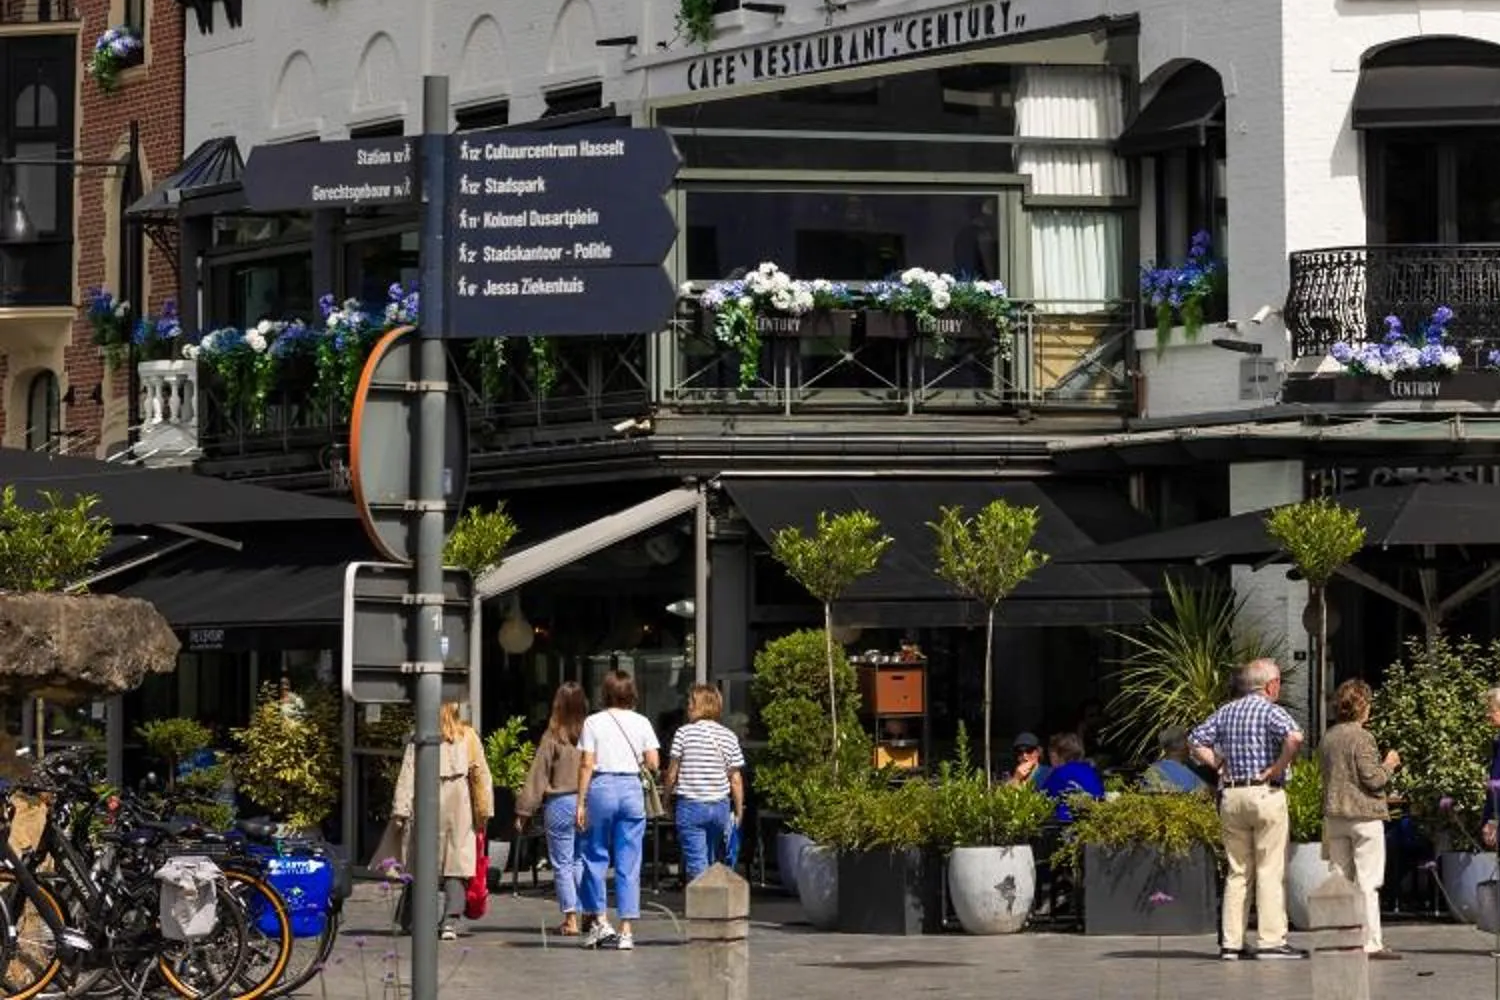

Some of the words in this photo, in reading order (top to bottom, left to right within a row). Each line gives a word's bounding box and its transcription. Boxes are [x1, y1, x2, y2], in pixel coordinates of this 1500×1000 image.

[357, 148, 391, 165] Station
[485, 142, 577, 160] Cultuurcentrum
[579, 139, 625, 157] Hasselt
[312, 183, 391, 203] Gerechtsgebouw
[485, 176, 545, 196] Stadspark
[483, 210, 527, 229] Kolonel
[529, 207, 599, 229] Dusartplein
[483, 244, 563, 262] Stadskantoor
[573, 241, 613, 260] Politie
[483, 279, 519, 297] Jessa
[521, 276, 584, 296] Ziekenhuis
[1390, 379, 1441, 397] CENTURY
